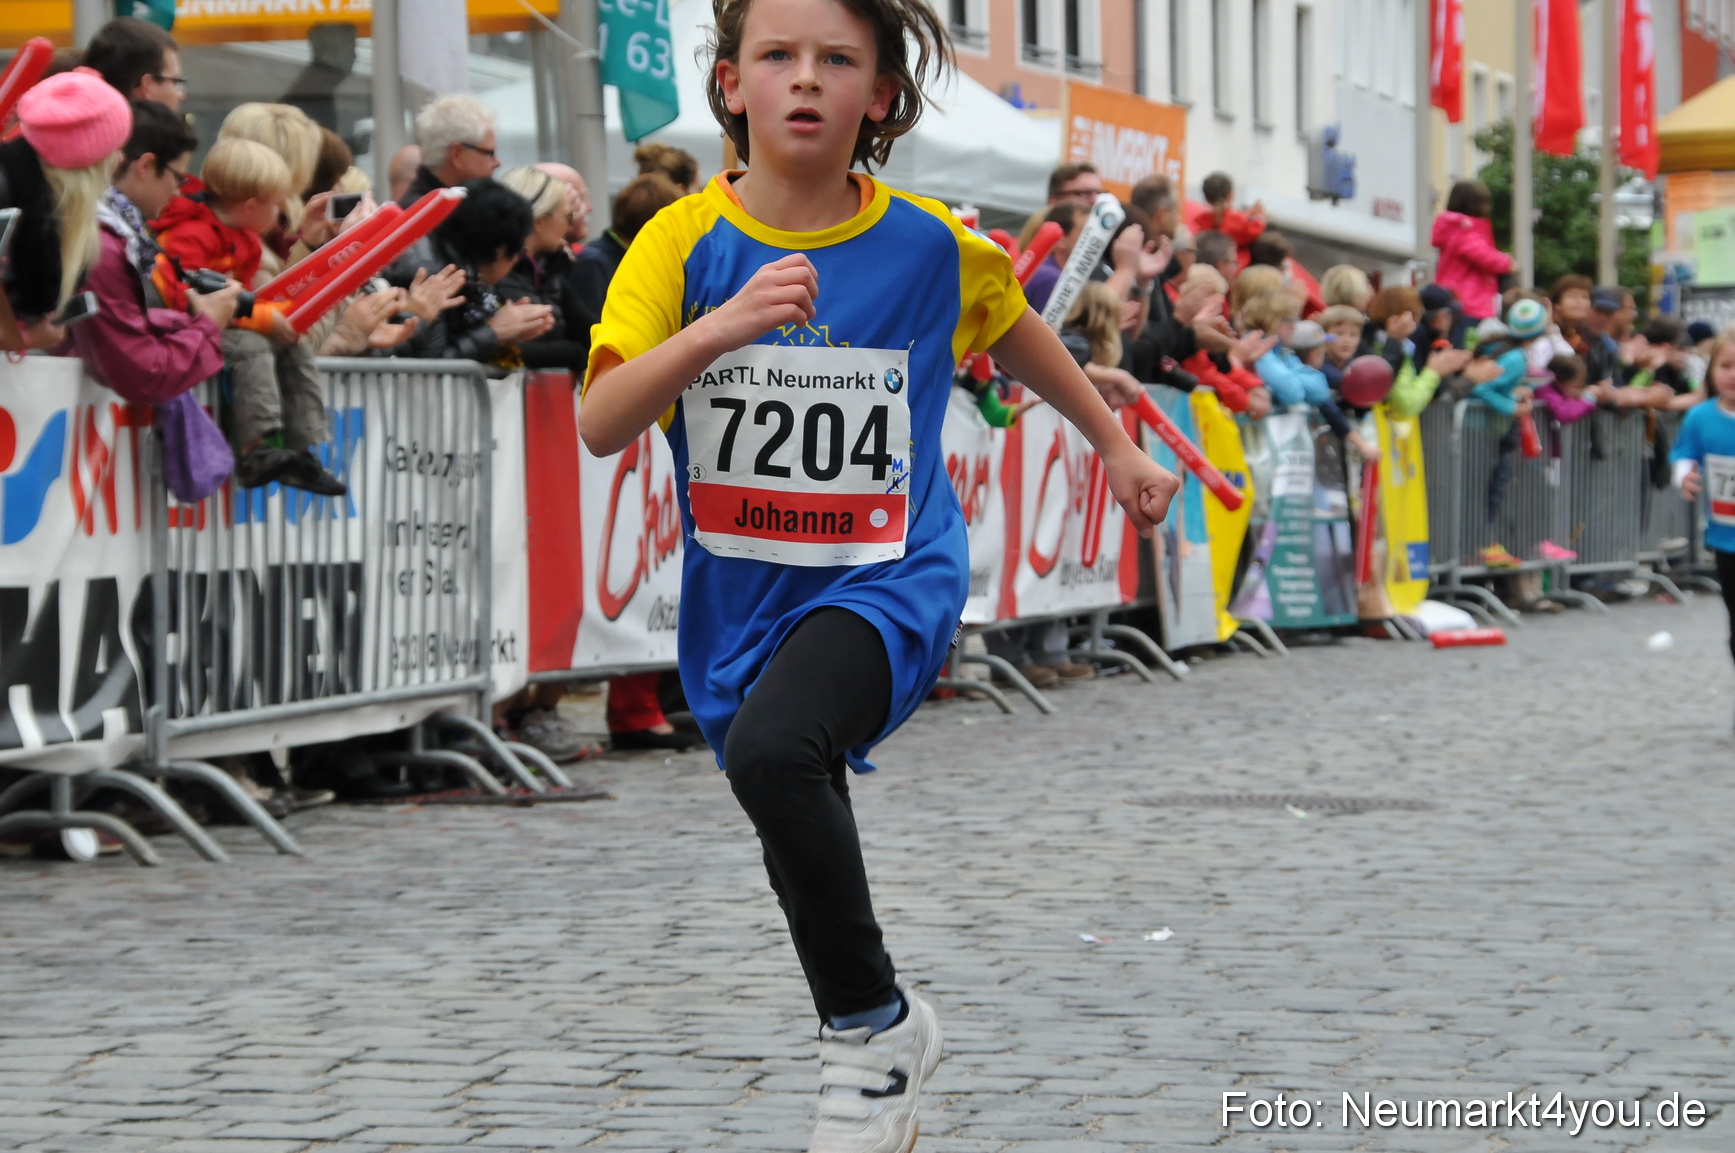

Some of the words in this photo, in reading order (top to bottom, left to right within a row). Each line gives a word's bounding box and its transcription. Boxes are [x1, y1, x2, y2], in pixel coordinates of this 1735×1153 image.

[767, 368, 876, 390] Neumarkt
[709, 397, 892, 482] 7204
[734, 498, 854, 535] Johanna
